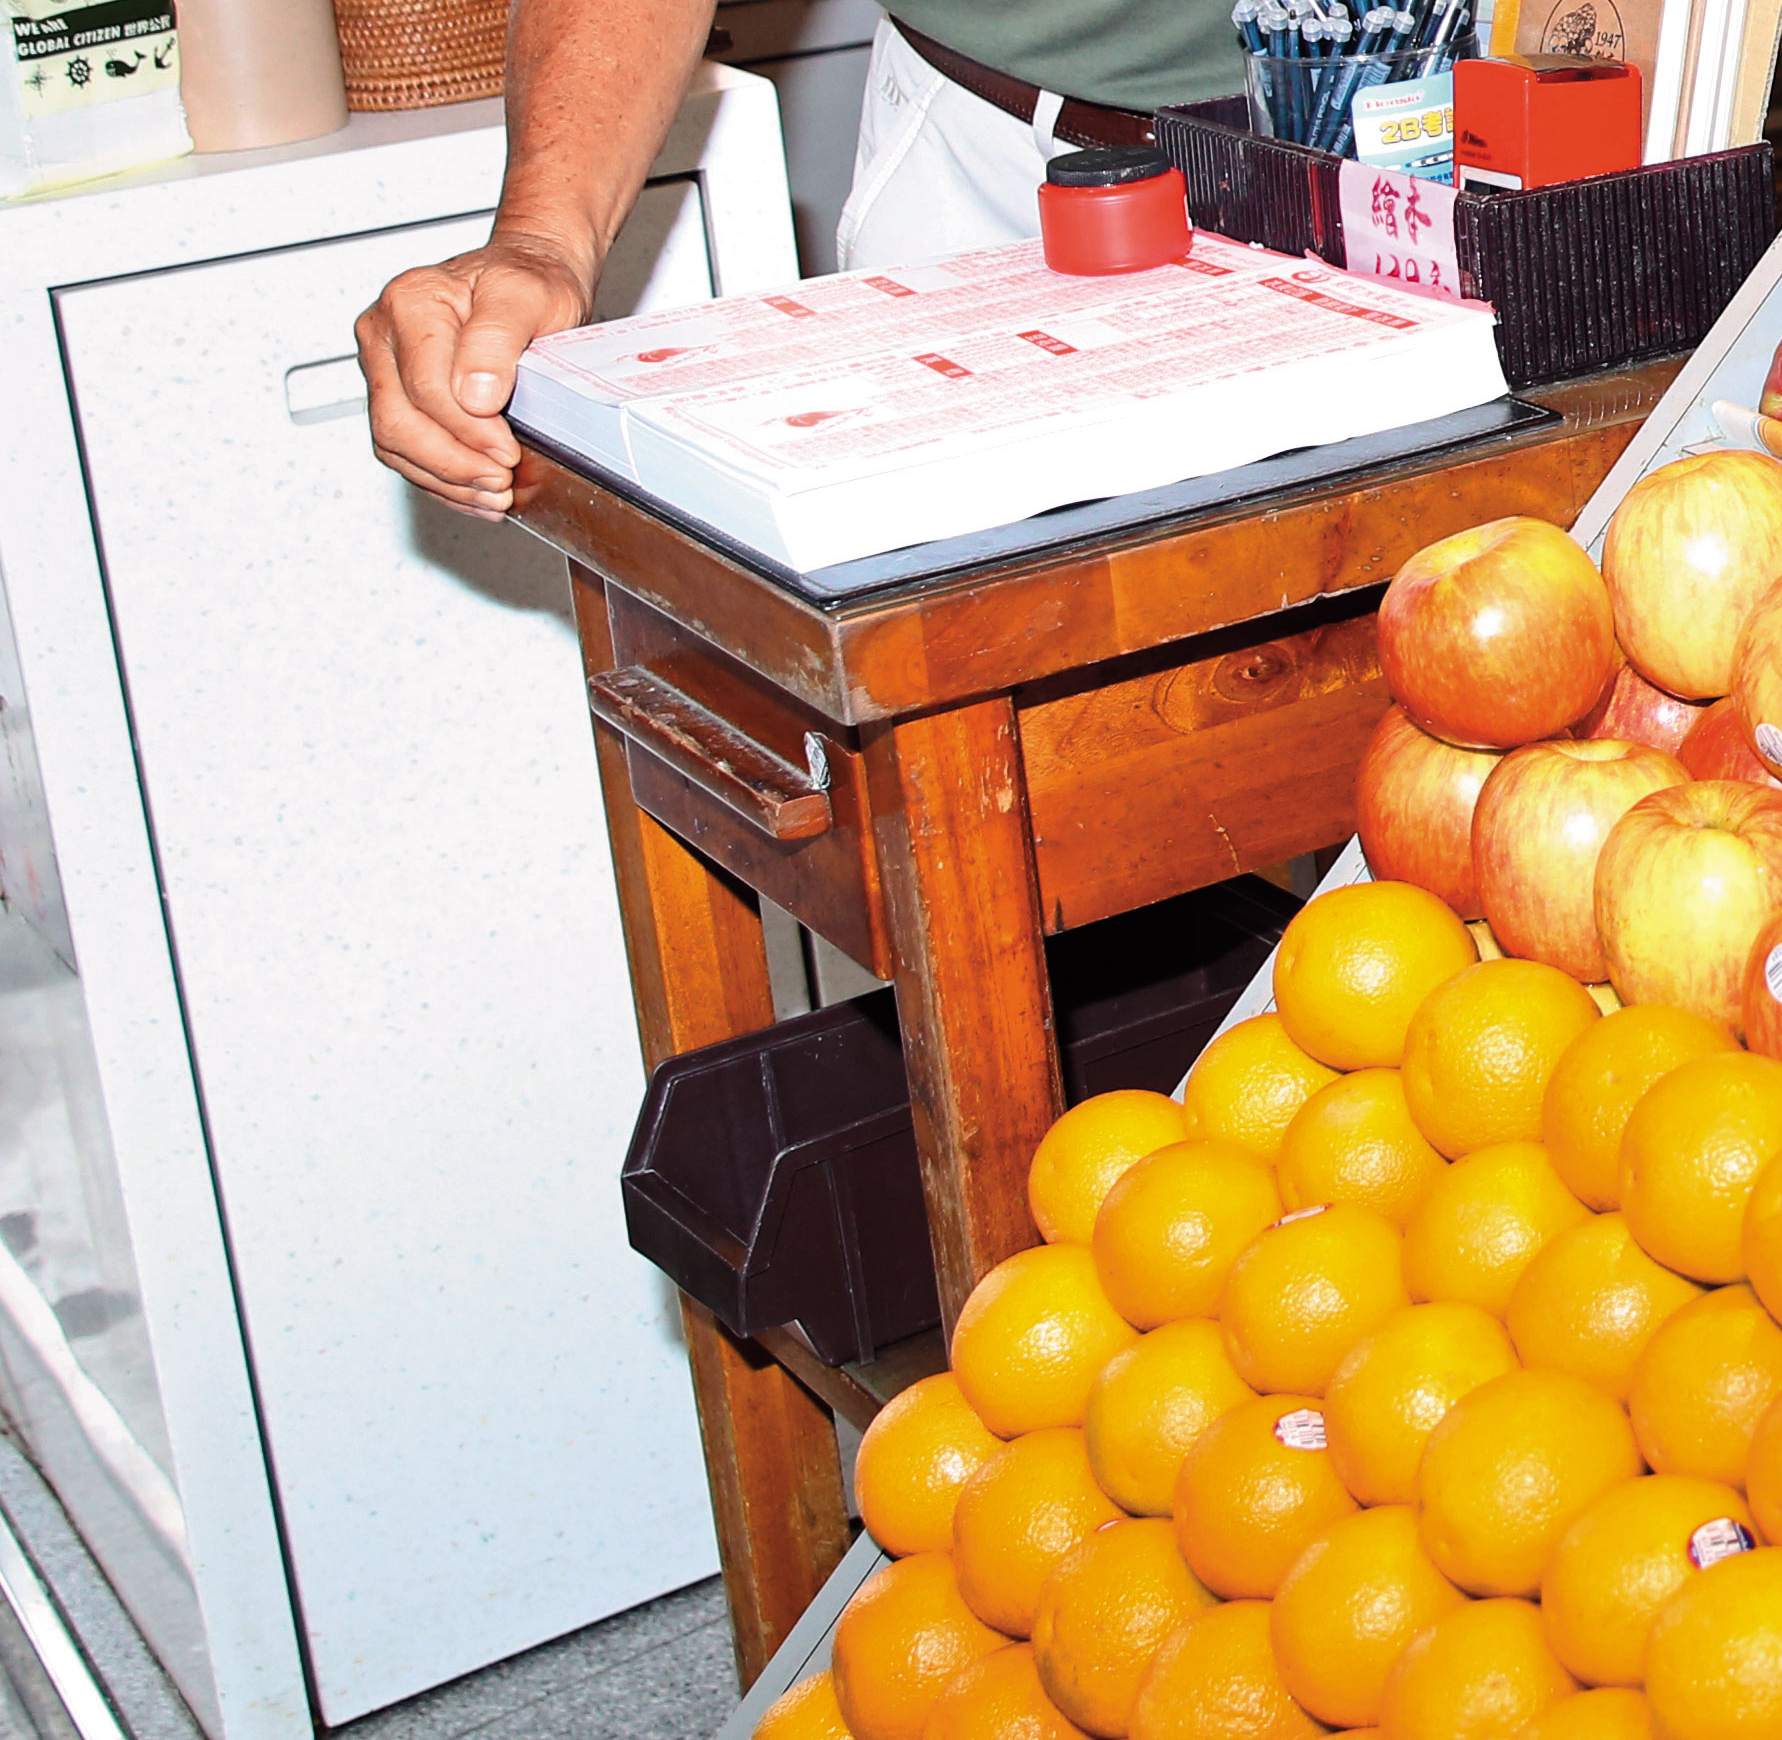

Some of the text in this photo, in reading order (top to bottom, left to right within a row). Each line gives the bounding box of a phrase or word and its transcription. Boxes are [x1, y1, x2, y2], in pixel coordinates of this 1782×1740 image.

[14, 22, 40, 38] WE
[18, 35, 71, 57] GLOBAL
[73, 25, 122, 47] CITIZEN
[1594, 30, 1623, 50] 1947
[1371, 173, 1433, 246] 繪本
